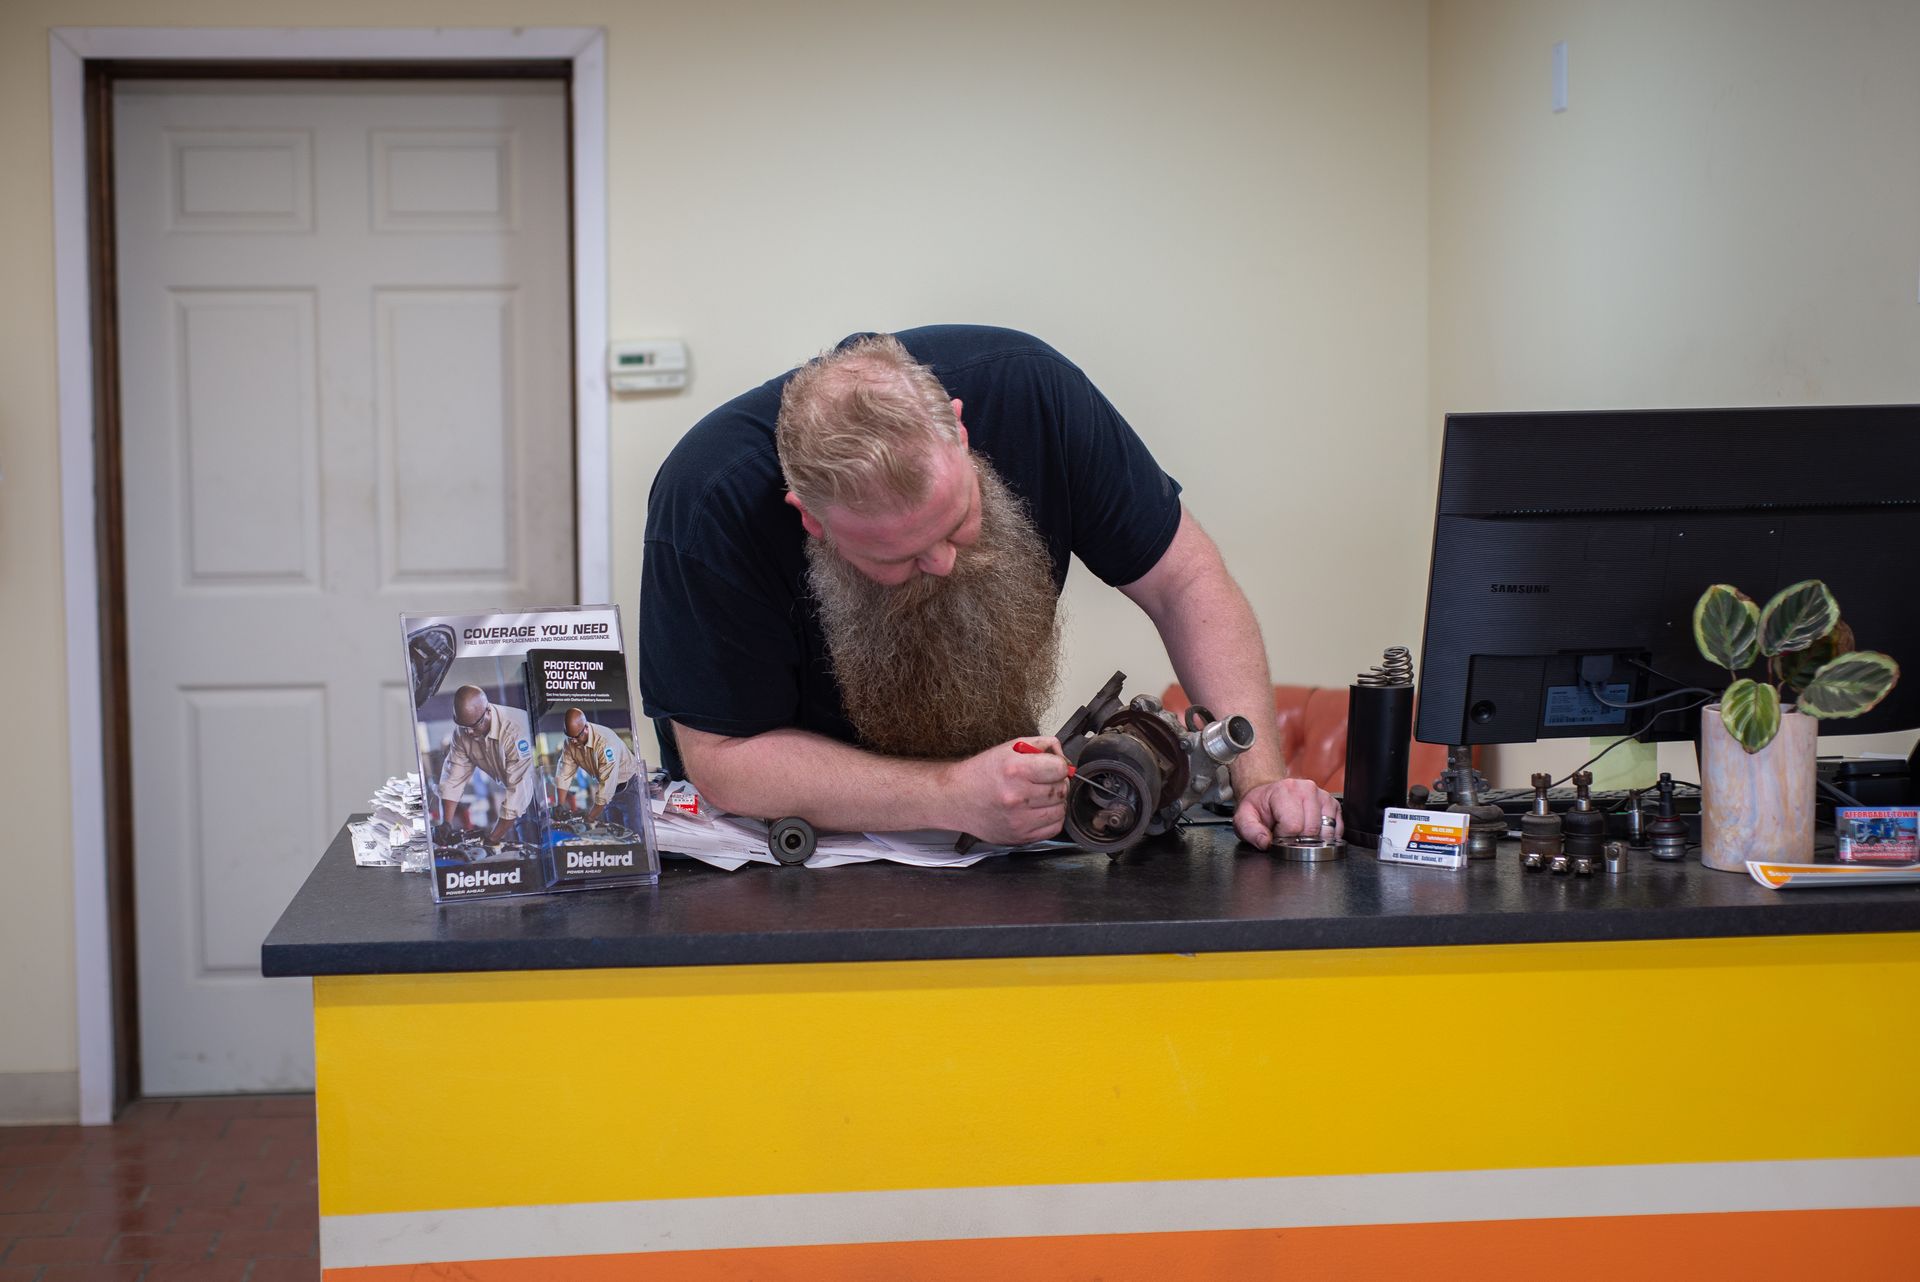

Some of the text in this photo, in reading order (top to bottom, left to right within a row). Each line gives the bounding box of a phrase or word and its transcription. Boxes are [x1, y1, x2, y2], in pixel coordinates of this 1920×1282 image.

[1491, 584, 1550, 593] SAMSUNG
[463, 623, 609, 639] COVERAGE YOU NEED
[543, 661, 604, 671] PROTECTION
[544, 671, 588, 680] YOU CAN
[545, 680, 596, 690] COUNT ON
[1388, 812, 1408, 820] JONATHAN
[1844, 811, 1892, 819] AFFORDABLE
[566, 851, 633, 868] DieHard
[446, 867, 521, 890] DieHard
